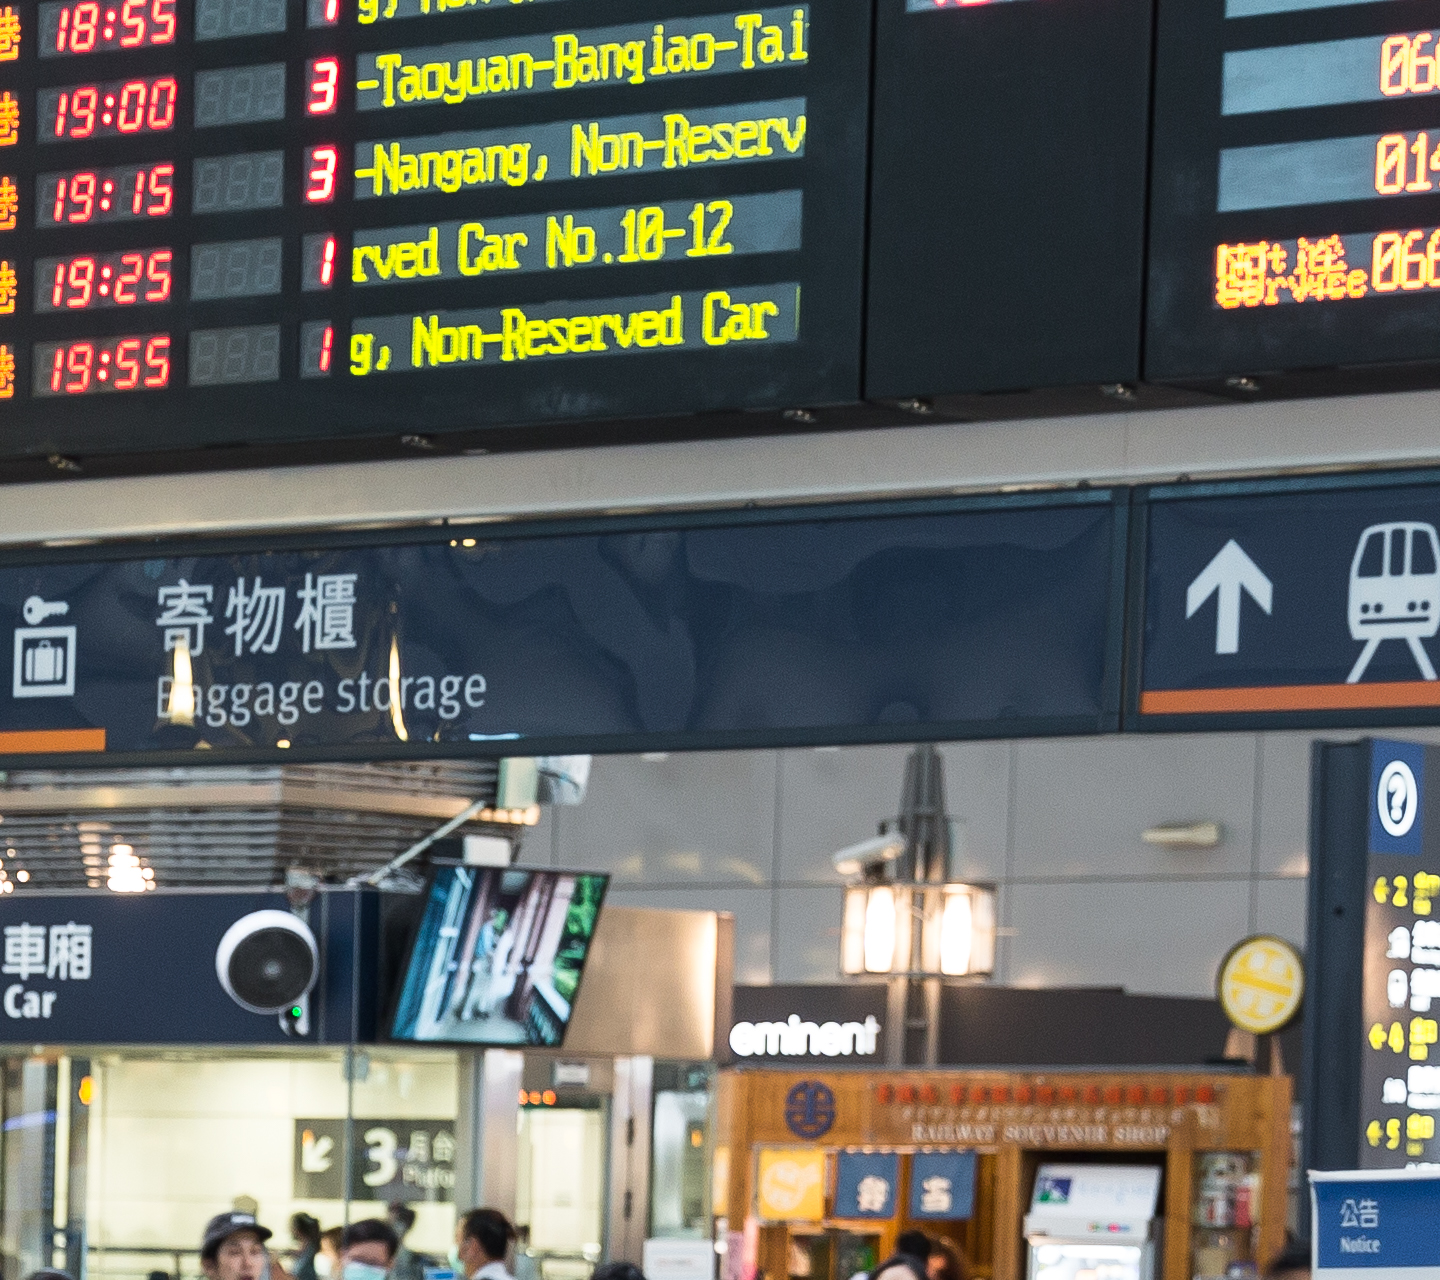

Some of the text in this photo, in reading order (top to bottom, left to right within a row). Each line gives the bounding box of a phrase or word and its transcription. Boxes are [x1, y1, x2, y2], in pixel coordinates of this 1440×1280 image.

[56, 0, 177, 53] 18:55
[55, 77, 178, 138] 19:00
[308, 57, 339, 113] 3
[570, 113, 807, 177] Non-Reserv
[54, 164, 174, 223] 19:15
[306, 147, 337, 201] 3
[321, 238, 335, 285] 1
[352, 201, 733, 282] rved Car No.10-12
[52, 251, 172, 308] 19:25
[321, 326, 333, 372] 1
[411, 294, 683, 368] Non-Reserved
[703, 291, 779, 347] Car
[51, 336, 171, 393] 19:55
[155, 573, 358, 657] 寄物櫃
[337, 669, 488, 716] storage
[1, 922, 93, 981] 車廂
[3, 983, 57, 1019] Car
[729, 1013, 881, 1057] eminent
[363, 1126, 399, 1187] 3
[1340, 1198, 1379, 1228] 公告
[1340, 1236, 1381, 1253] Notice
